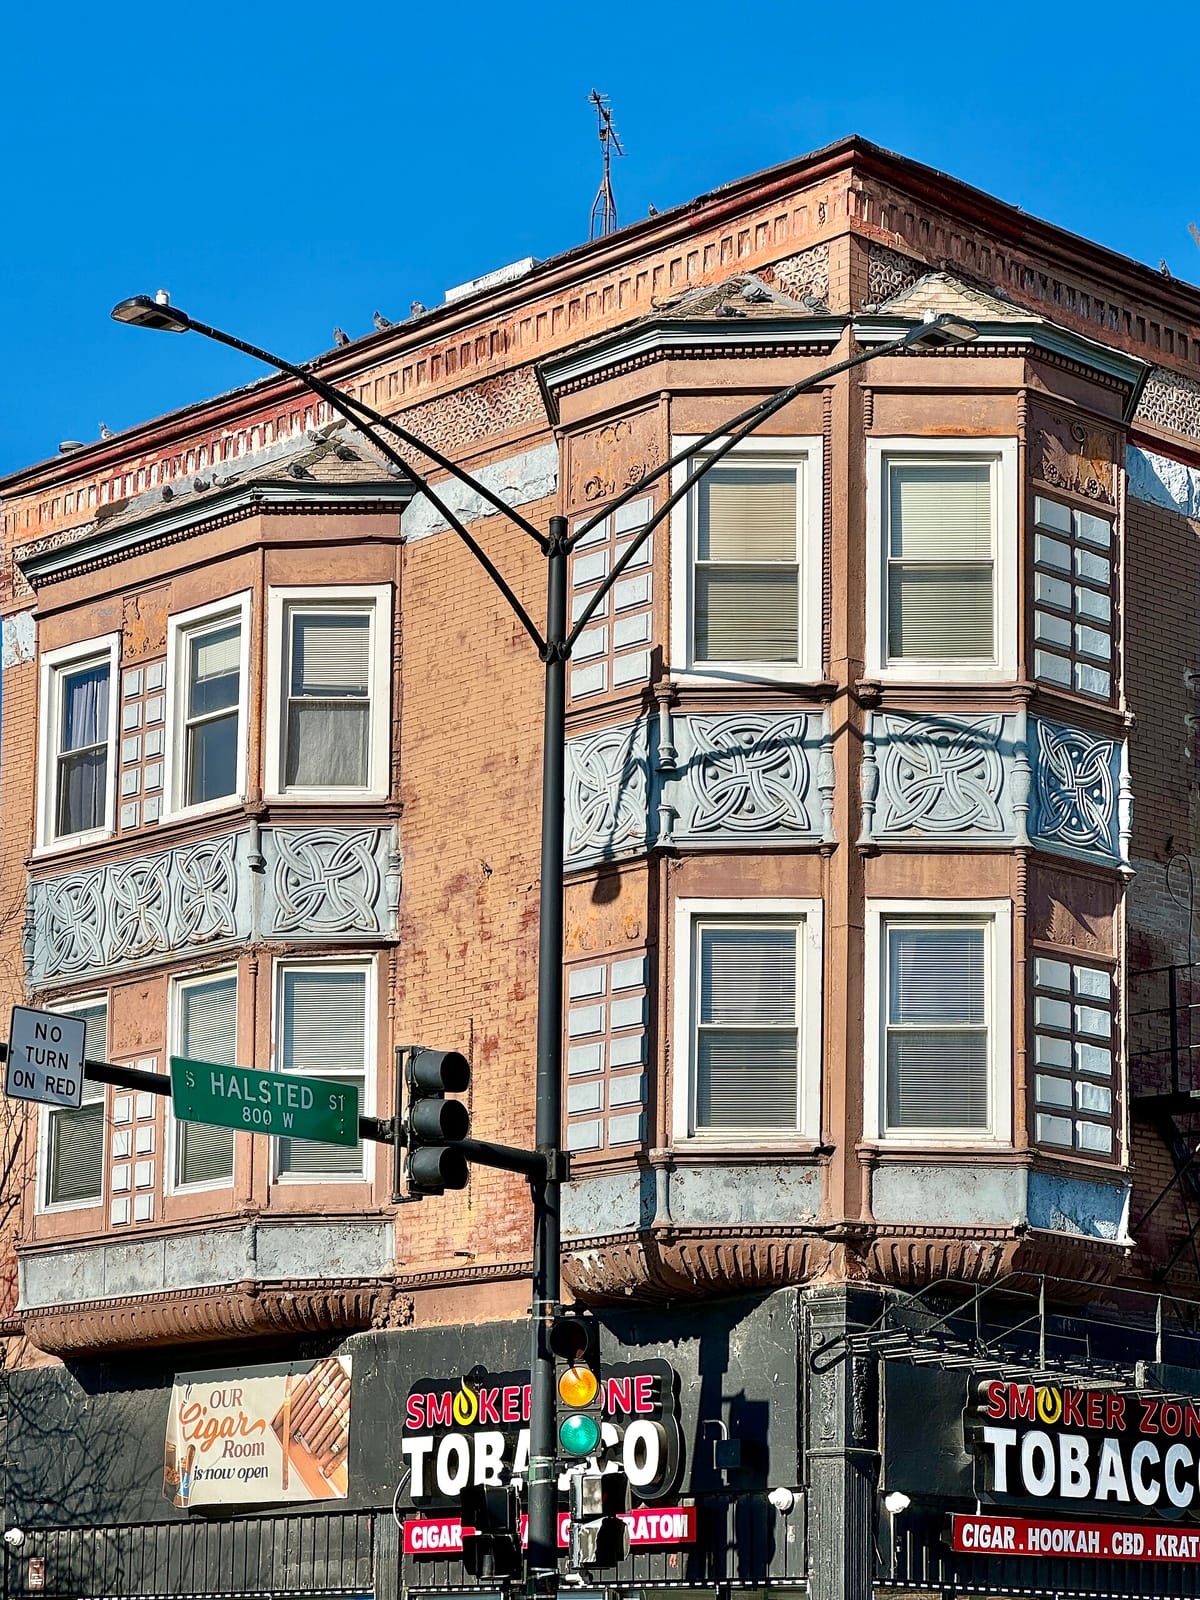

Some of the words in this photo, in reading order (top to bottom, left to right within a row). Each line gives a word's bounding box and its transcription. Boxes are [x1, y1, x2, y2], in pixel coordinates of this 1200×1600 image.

[34, 1022, 62, 1043] NO
[25, 1045, 69, 1070] TURN
[13, 1069, 36, 1090] ON
[45, 1075, 76, 1096] RED
[185, 1070, 195, 1088] S
[210, 1072, 314, 1110] HALSTED
[328, 1094, 346, 1112] ST
[242, 1106, 272, 1126] 800
[283, 1112, 294, 1129] W
[209, 1388, 243, 1409] OUR
[600, 1375, 654, 1415] NE
[986, 1380, 1127, 1431] SMOKER
[179, 1402, 267, 1453] Cigar
[221, 1439, 265, 1458] Room
[193, 1465, 204, 1481] is
[204, 1467, 236, 1480] now
[237, 1466, 269, 1483] open
[983, 1426, 1200, 1508] TOBACC
[411, 1524, 463, 1549] CIGAR
[622, 1514, 689, 1540] RATOM
[1155, 1534, 1200, 1559] KRAT
